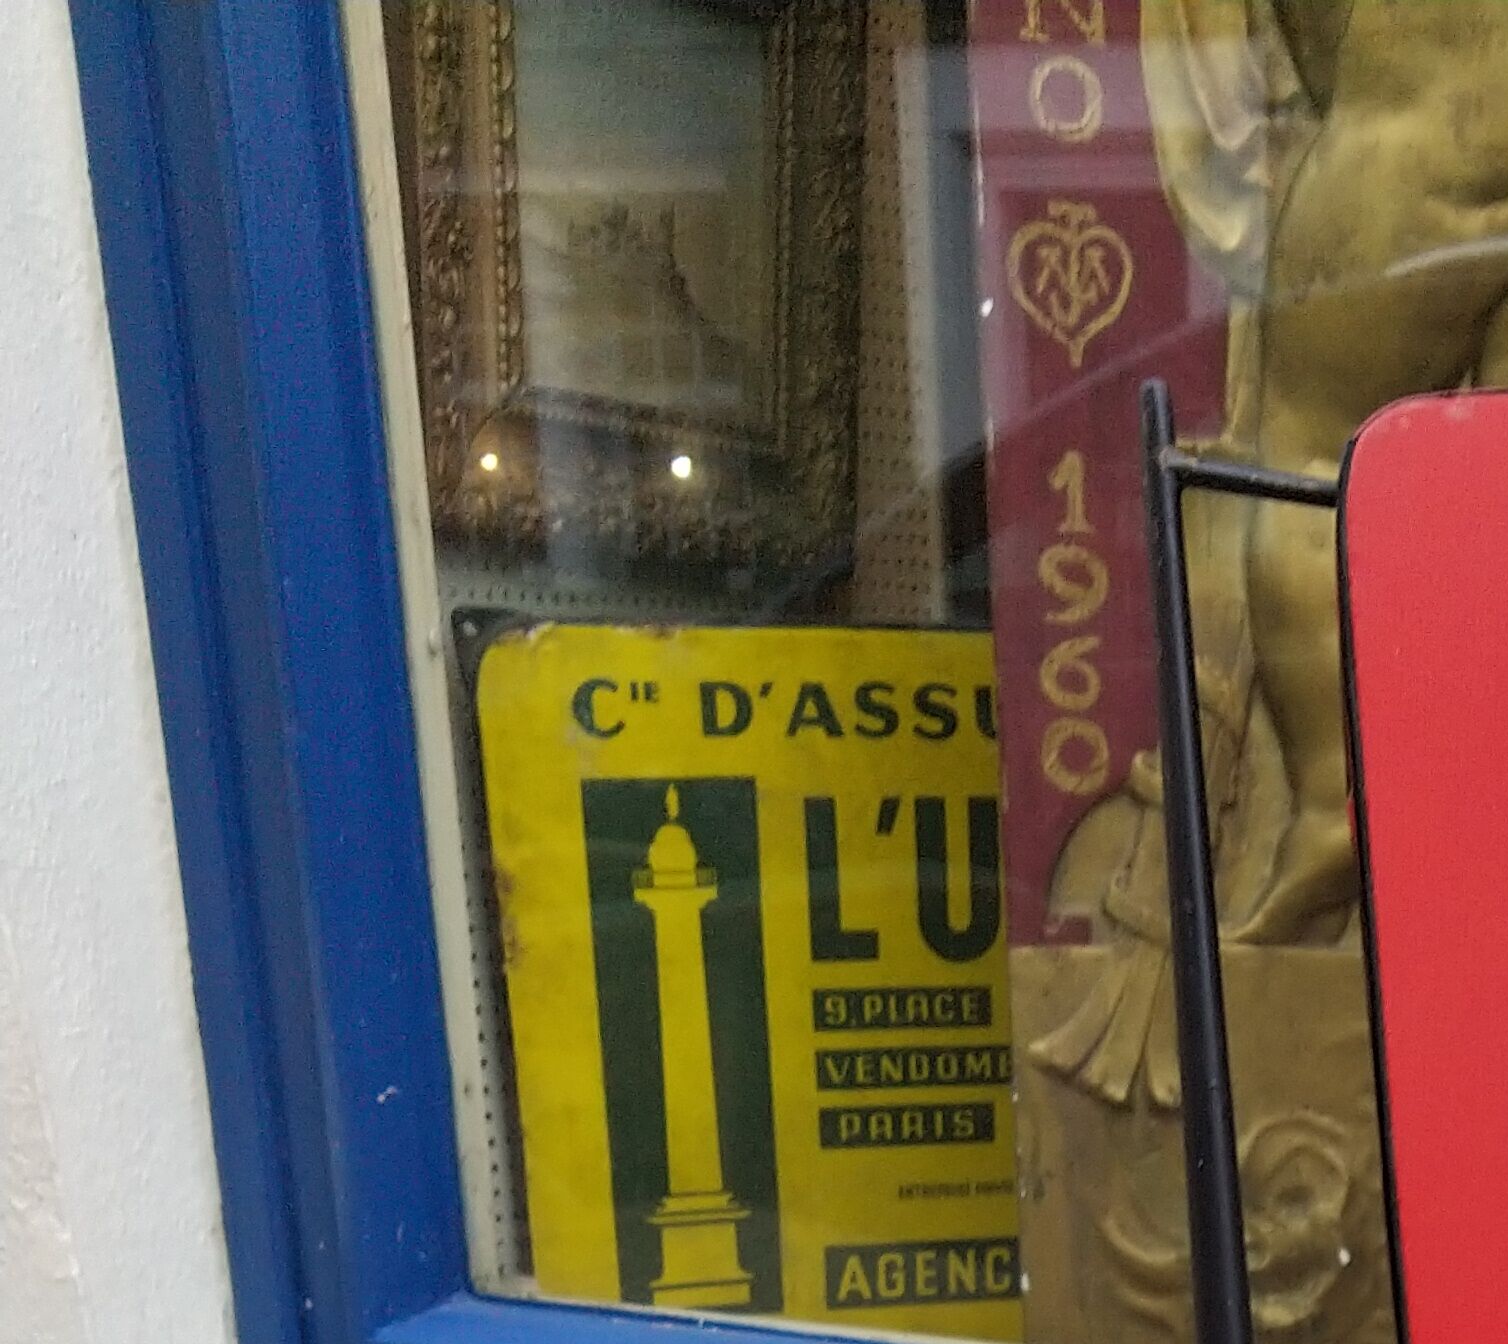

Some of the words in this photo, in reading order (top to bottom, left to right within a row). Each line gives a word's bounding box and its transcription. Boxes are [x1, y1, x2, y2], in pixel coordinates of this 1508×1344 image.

[1038, 450, 1110, 796] 1960
[803, 796, 999, 963] L'U
[838, 1107, 976, 1142] PARIS
[836, 1246, 1012, 1302] AGENC
